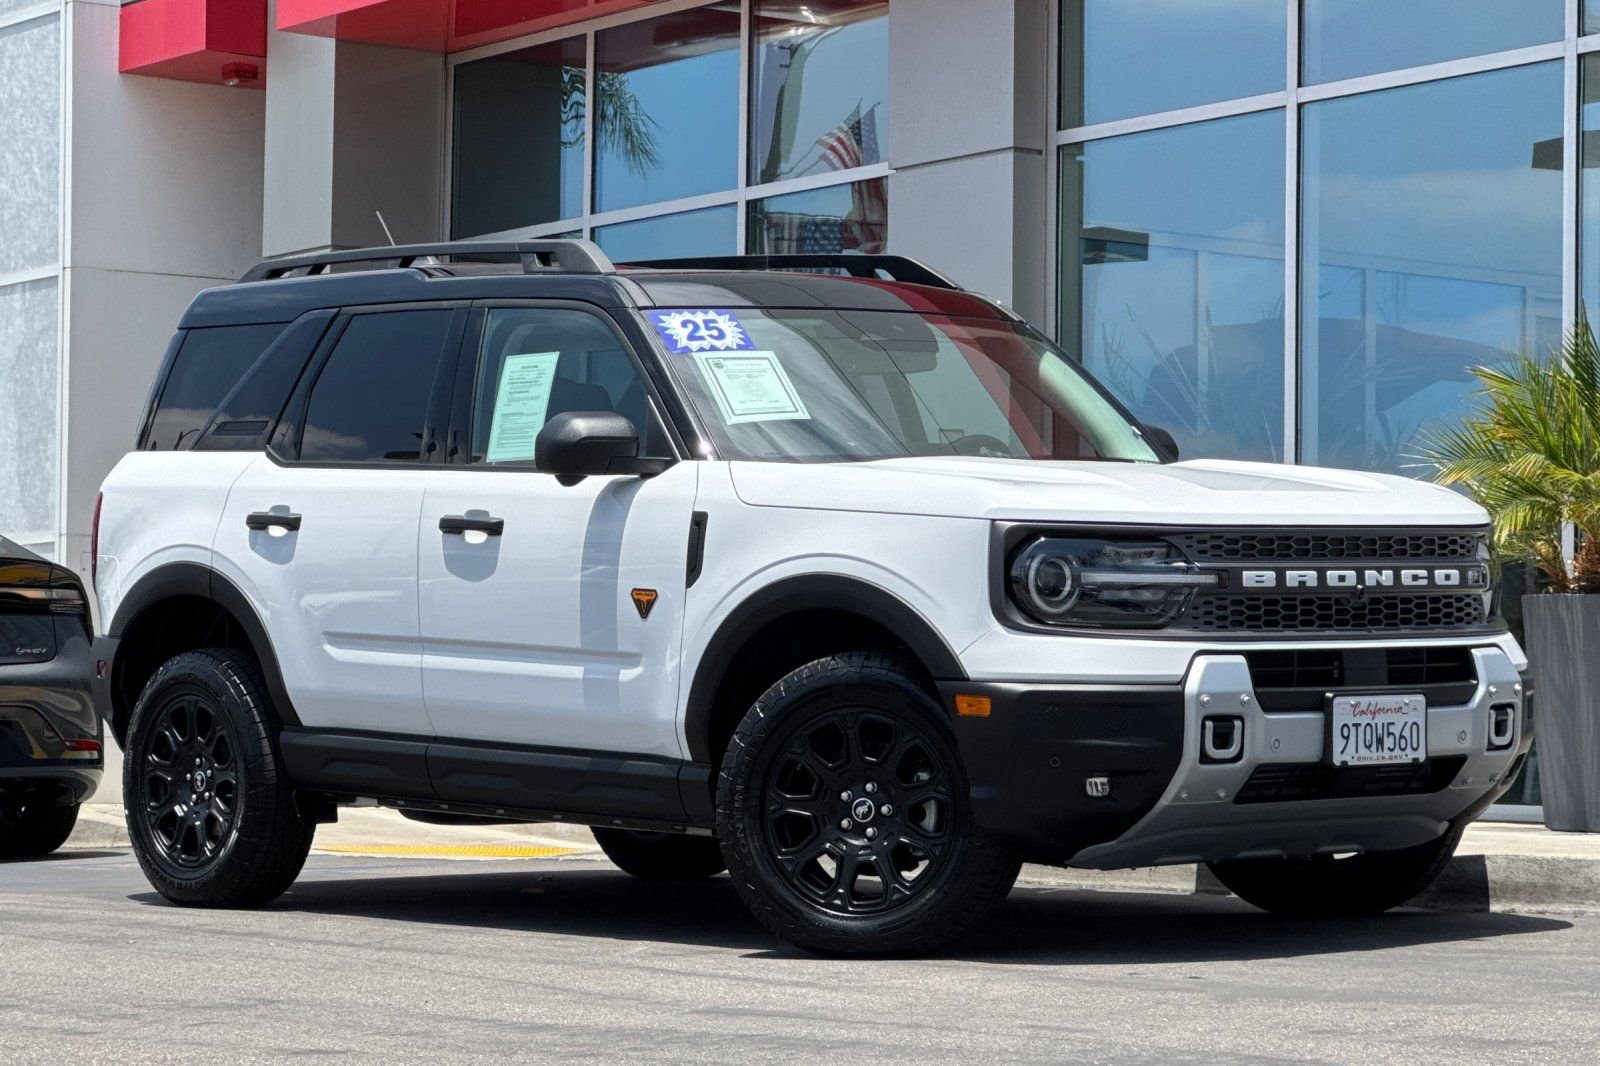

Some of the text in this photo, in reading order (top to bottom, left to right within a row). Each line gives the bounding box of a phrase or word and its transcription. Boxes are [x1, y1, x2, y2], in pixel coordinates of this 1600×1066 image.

[680, 318, 726, 341] 25
[1242, 569, 1460, 587] BRONCO
[1352, 702, 1408, 720] California
[1340, 721, 1420, 754] 9TQW560
